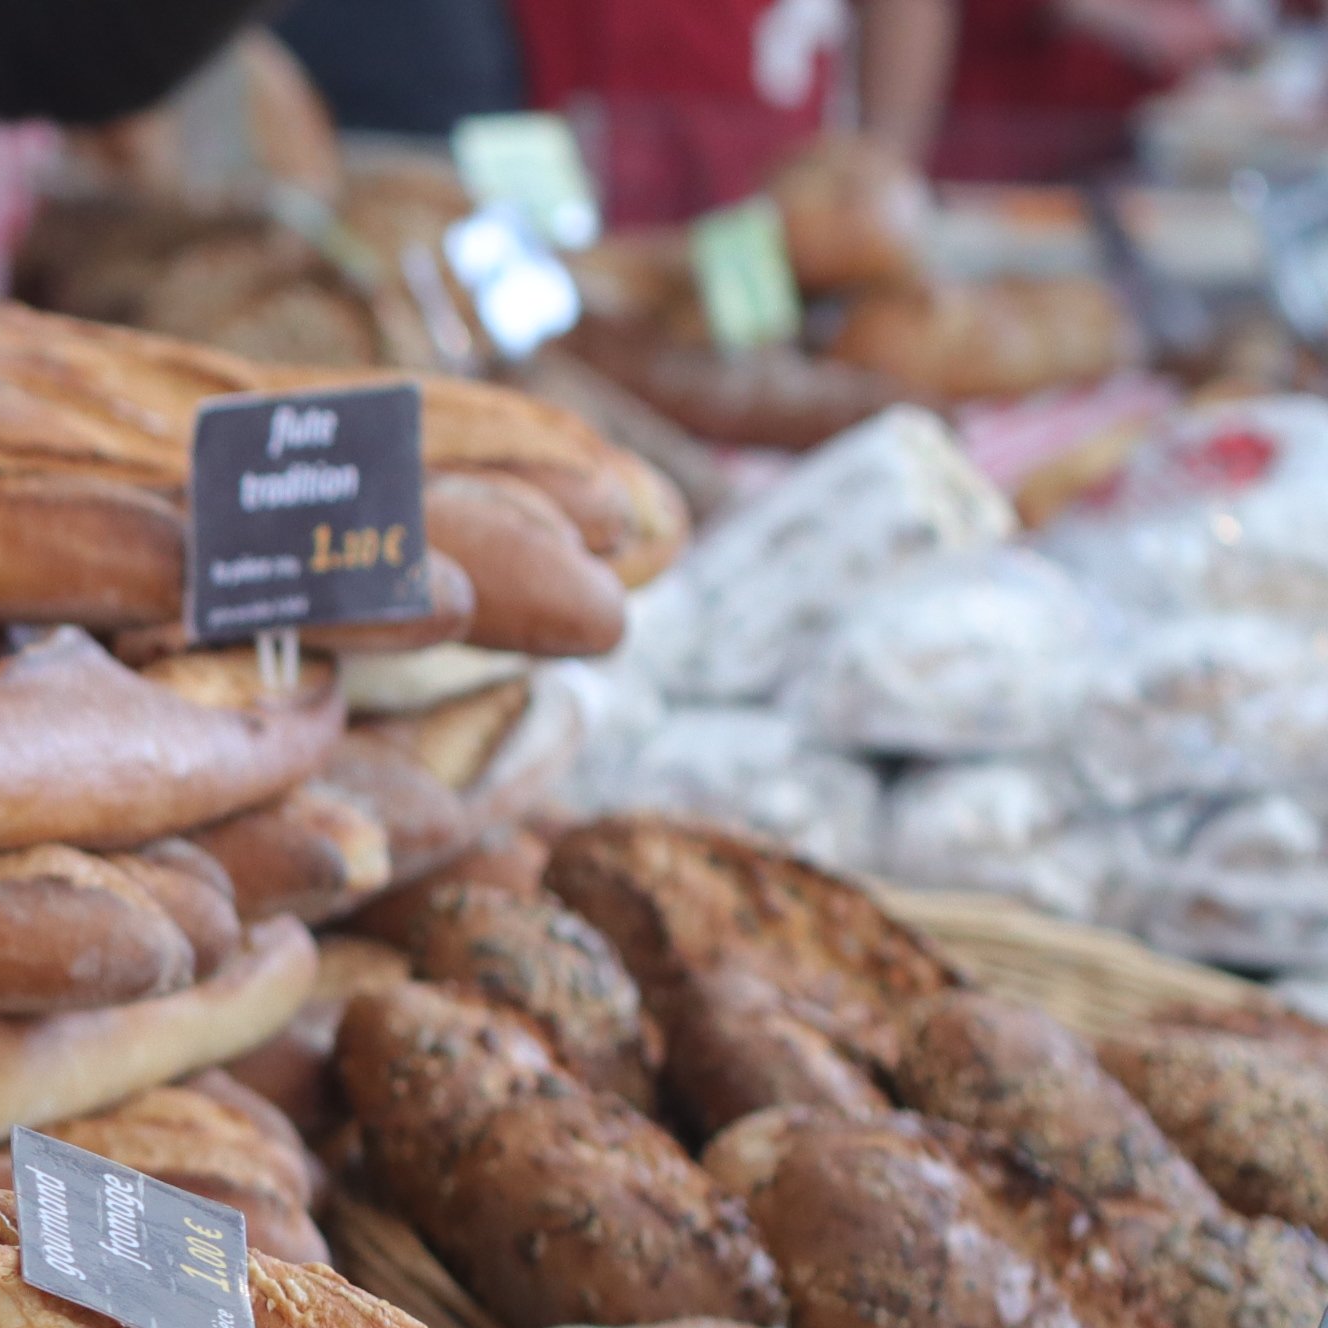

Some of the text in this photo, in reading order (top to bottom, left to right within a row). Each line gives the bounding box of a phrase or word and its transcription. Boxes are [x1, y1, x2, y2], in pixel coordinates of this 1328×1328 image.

[239, 460, 360, 512] tradition
[25, 1164, 87, 1281] gourmand
[99, 1173, 152, 1271] fromage
[184, 1217, 223, 1240] €
[180, 1235, 230, 1293] 1.00
